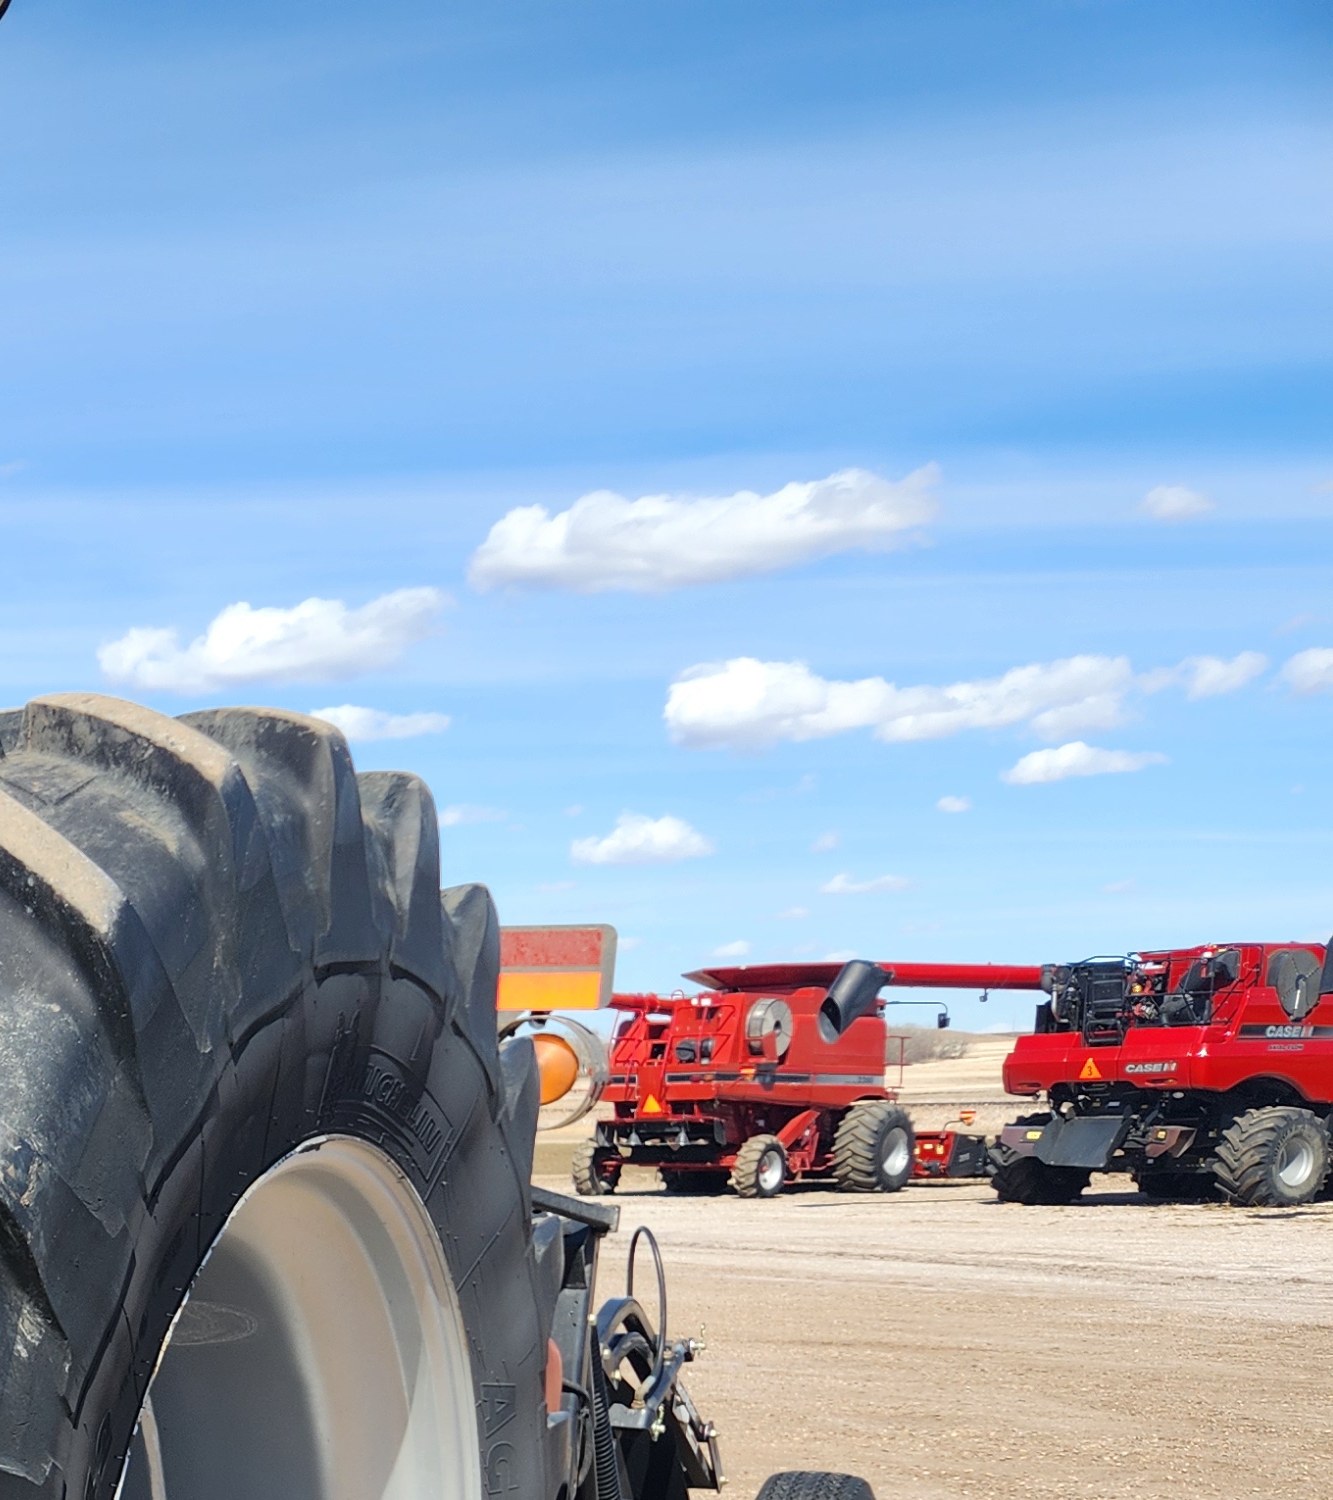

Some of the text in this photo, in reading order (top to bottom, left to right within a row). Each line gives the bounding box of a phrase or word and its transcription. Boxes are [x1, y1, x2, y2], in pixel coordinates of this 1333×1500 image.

[1265, 1025, 1302, 1038] CASE
[1087, 1065, 1093, 1077] 3
[1125, 1063, 1163, 1073] CASE
